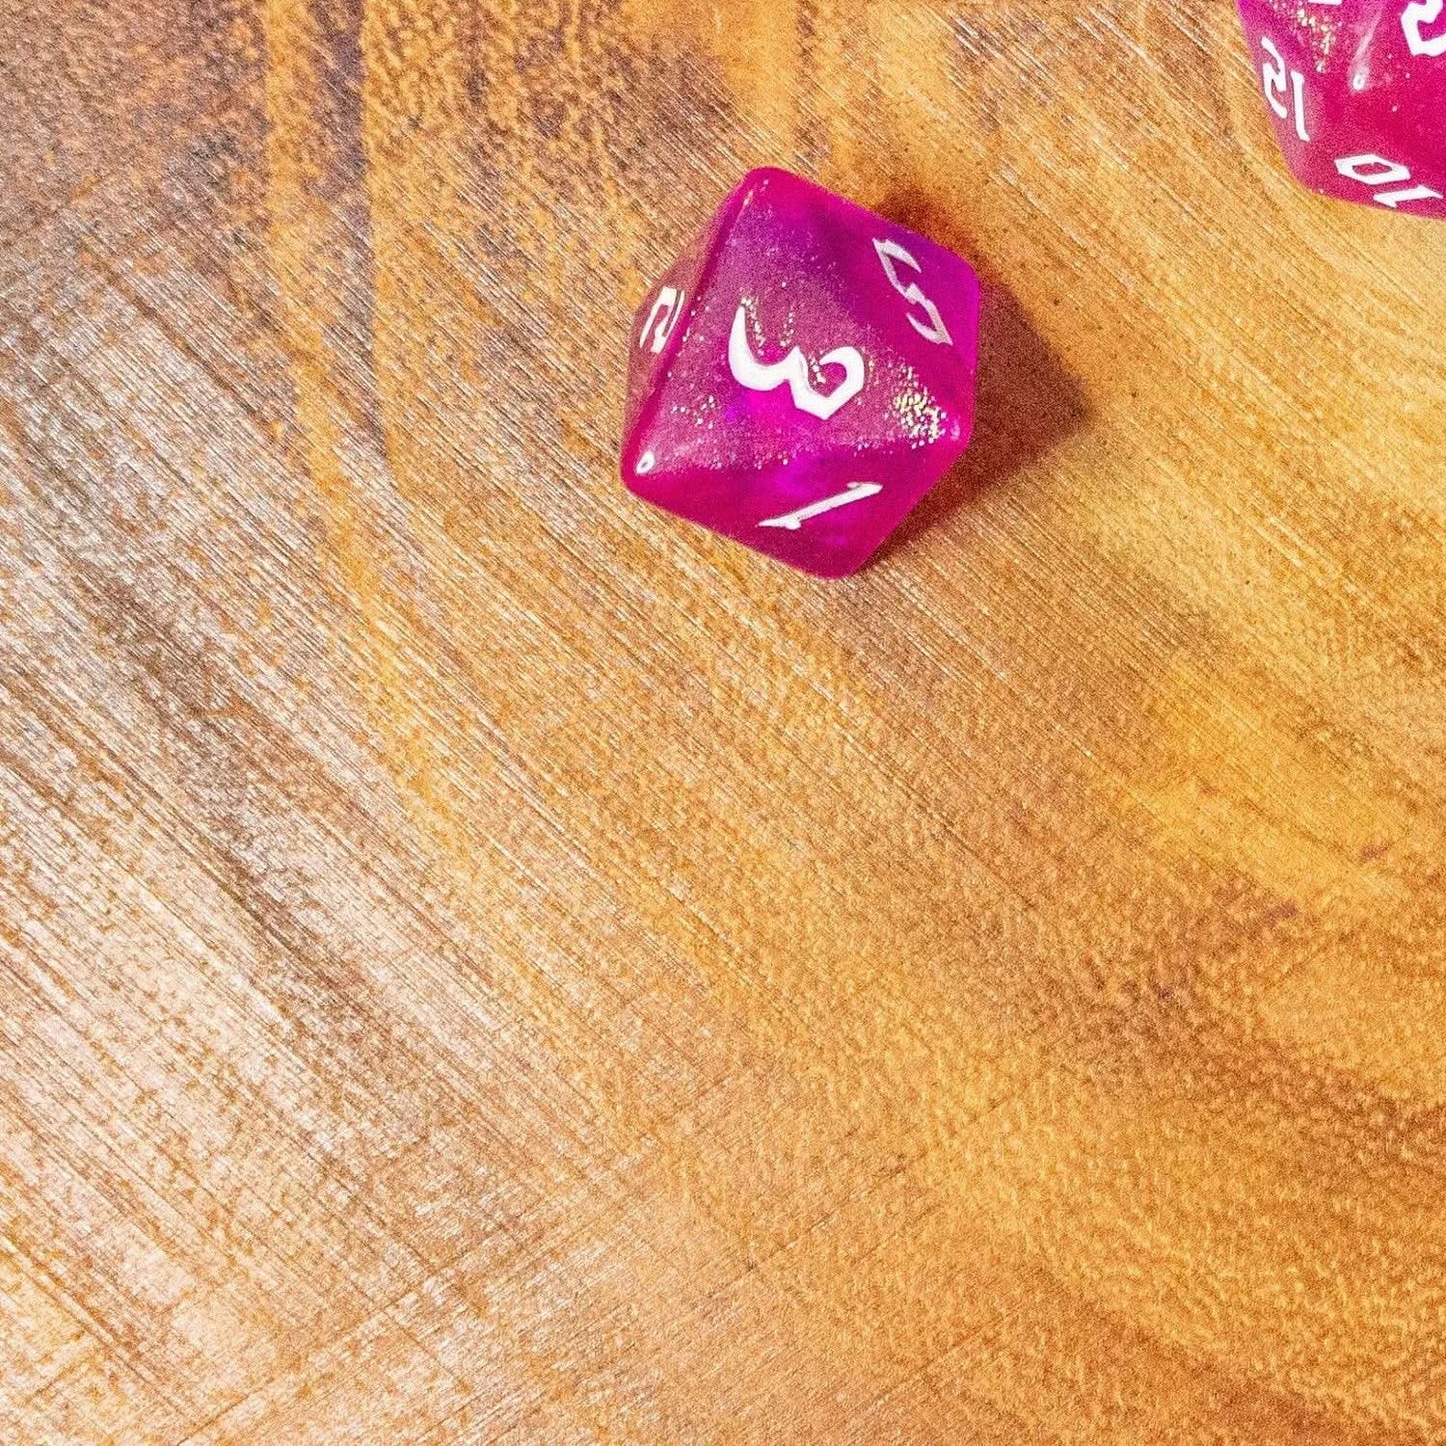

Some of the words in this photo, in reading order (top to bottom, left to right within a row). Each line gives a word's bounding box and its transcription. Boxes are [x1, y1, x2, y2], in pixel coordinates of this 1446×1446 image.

[1334, 153, 1444, 209] 10
[872, 237, 953, 347] 5
[728, 305, 865, 421] 3
[755, 482, 884, 531] 1
